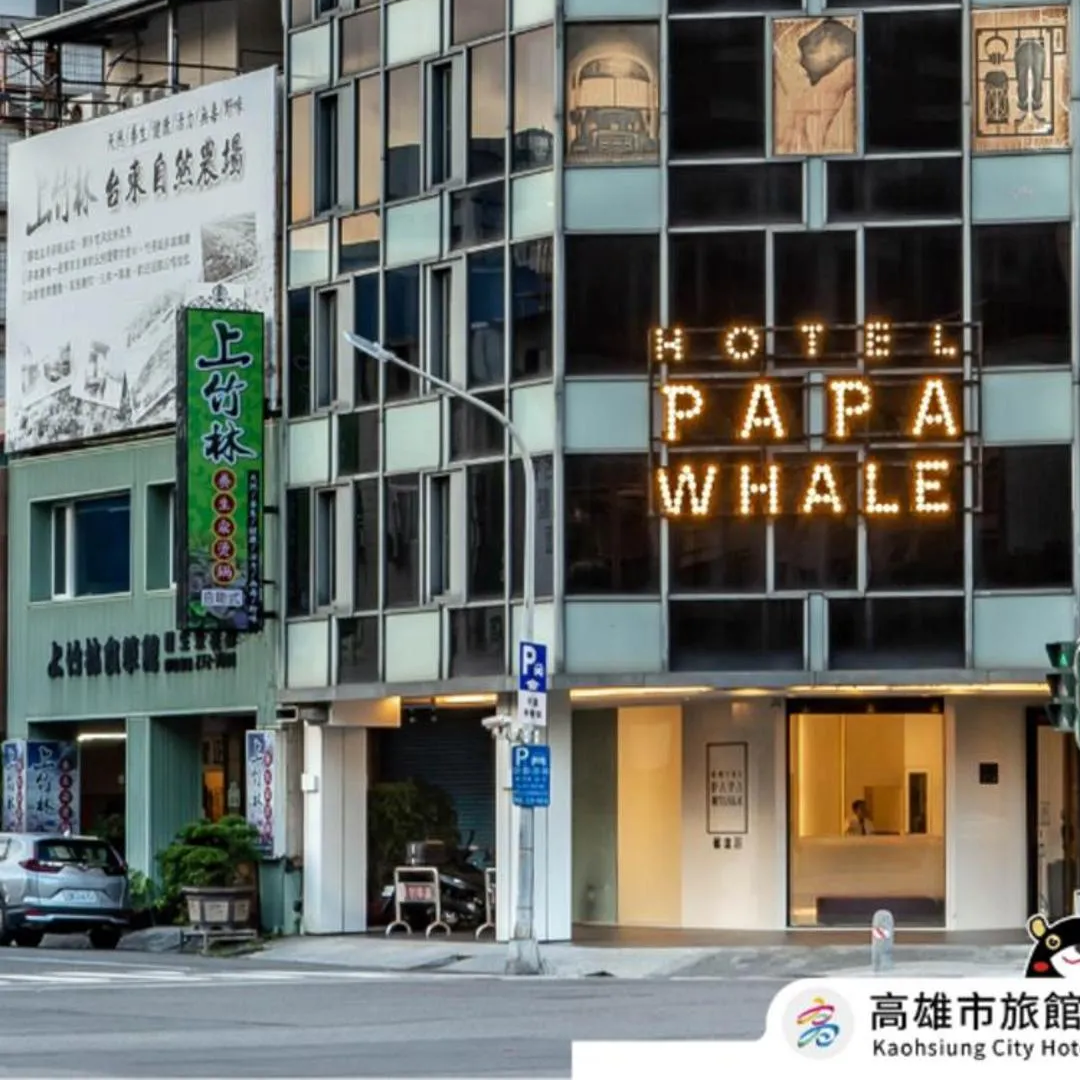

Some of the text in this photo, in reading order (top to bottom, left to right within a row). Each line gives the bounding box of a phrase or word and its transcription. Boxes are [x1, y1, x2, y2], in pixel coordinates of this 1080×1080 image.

[654, 321, 957, 361] HOTEL
[196, 320, 257, 465] 上竹林
[661, 378, 957, 441] PAPA
[656, 459, 949, 515] WHALE
[522, 645, 537, 676] P
[515, 747, 530, 768] P
